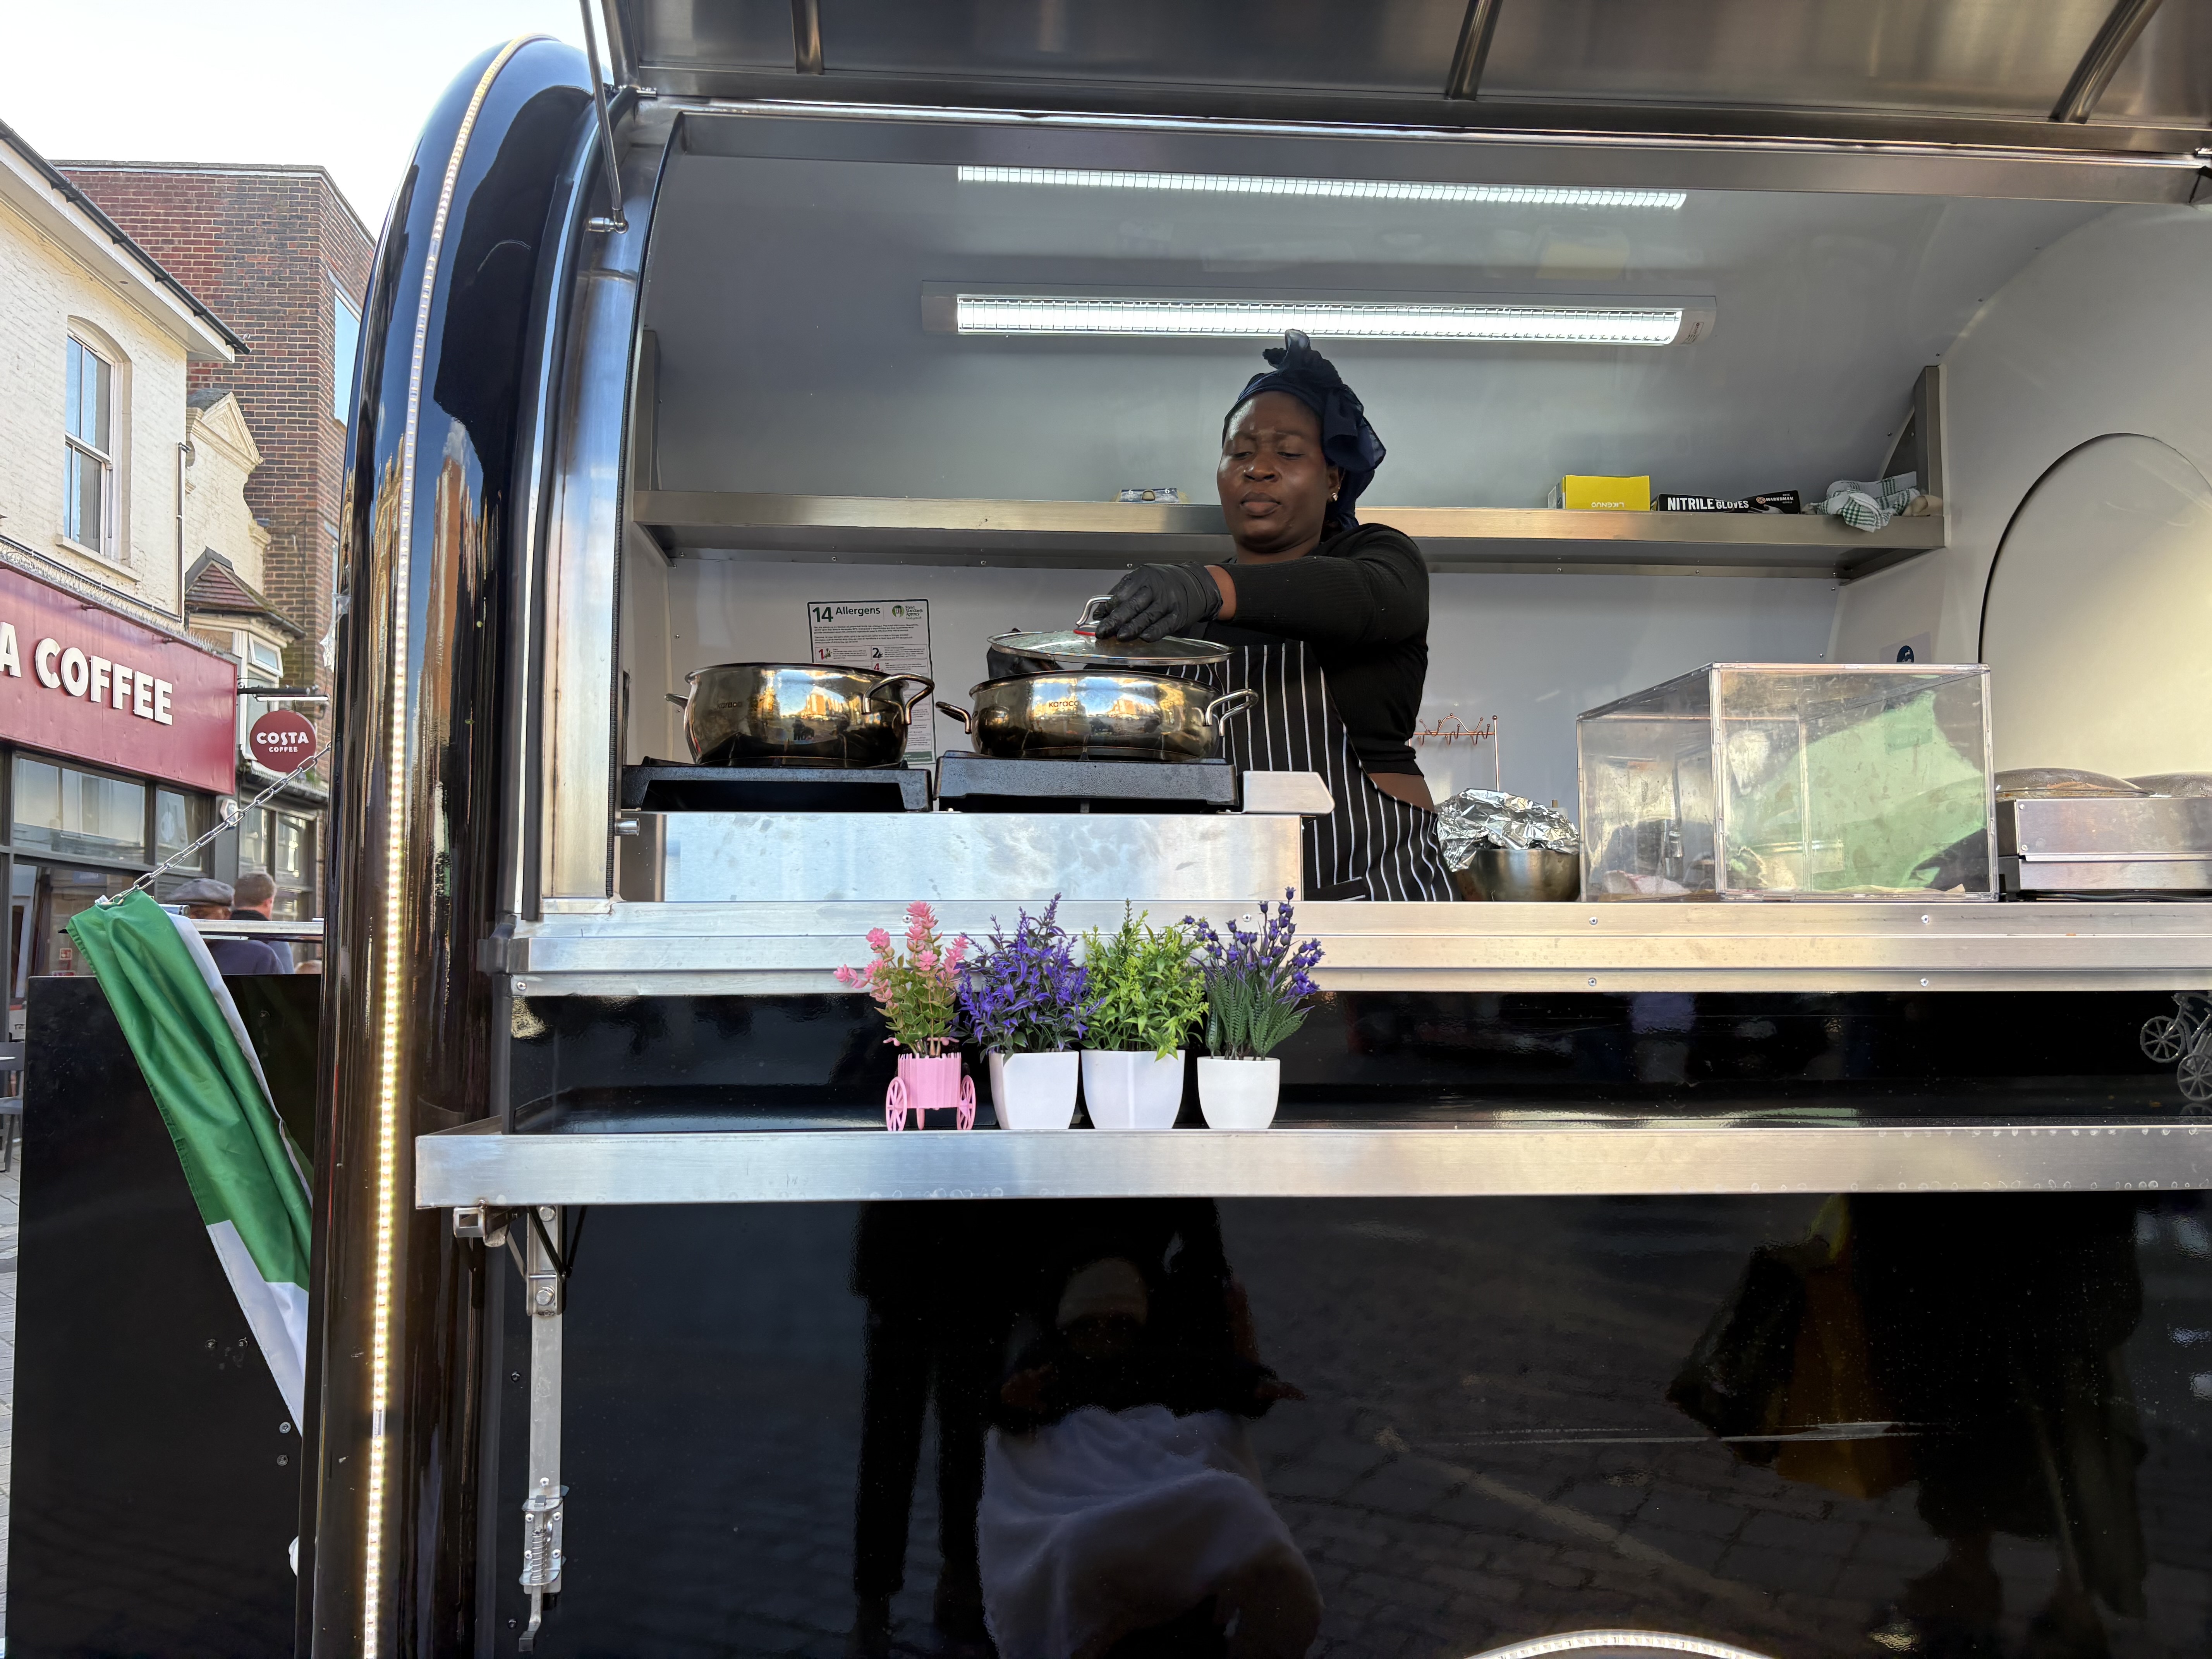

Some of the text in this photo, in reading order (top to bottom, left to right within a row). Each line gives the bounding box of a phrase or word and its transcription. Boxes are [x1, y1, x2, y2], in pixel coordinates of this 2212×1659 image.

[1668, 497, 1749, 510] NITRILE GLOVES
[812, 606, 881, 623] 14 Allergens
[818, 649, 824, 660] 1
[872, 648, 880, 658] 2
[0, 622, 173, 725] A COFFEE
[256, 732, 309, 745] COSTA
